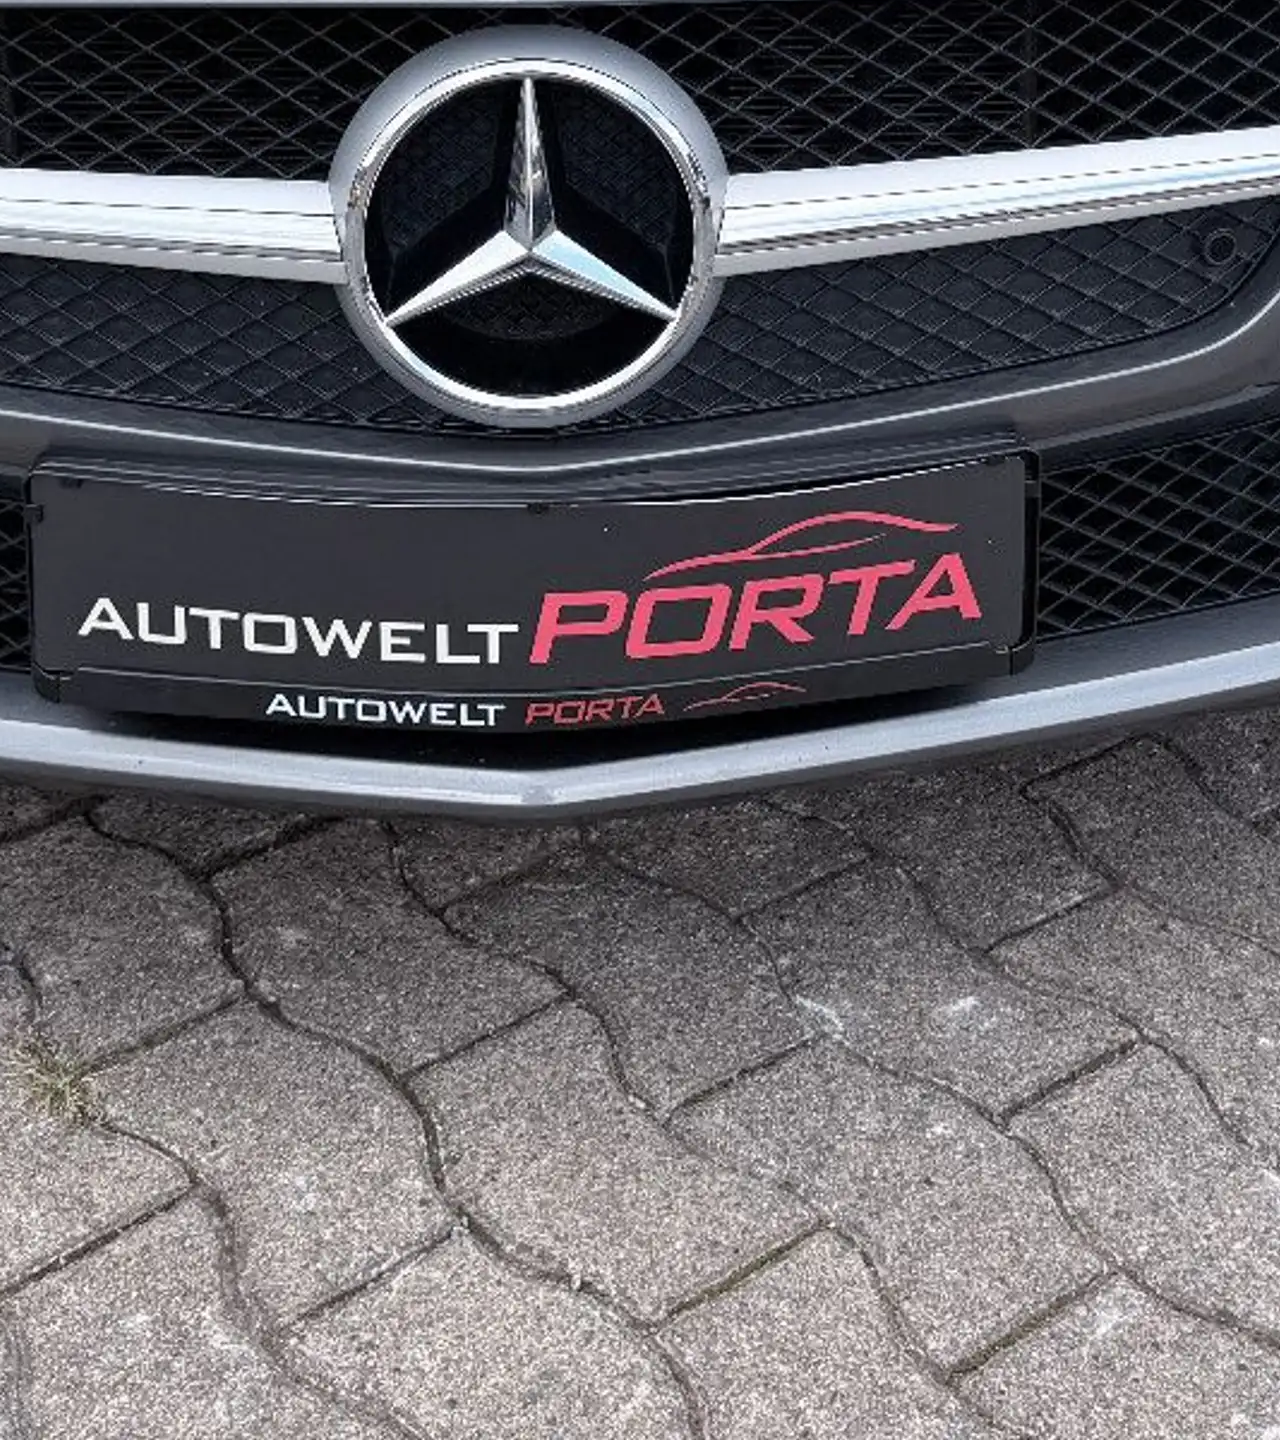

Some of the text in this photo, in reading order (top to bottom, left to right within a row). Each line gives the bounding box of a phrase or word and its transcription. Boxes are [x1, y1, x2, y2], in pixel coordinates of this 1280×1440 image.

[78, 553, 983, 664] AUTOWELT PORTA
[265, 693, 665, 727] AUTOWELT PORTA
